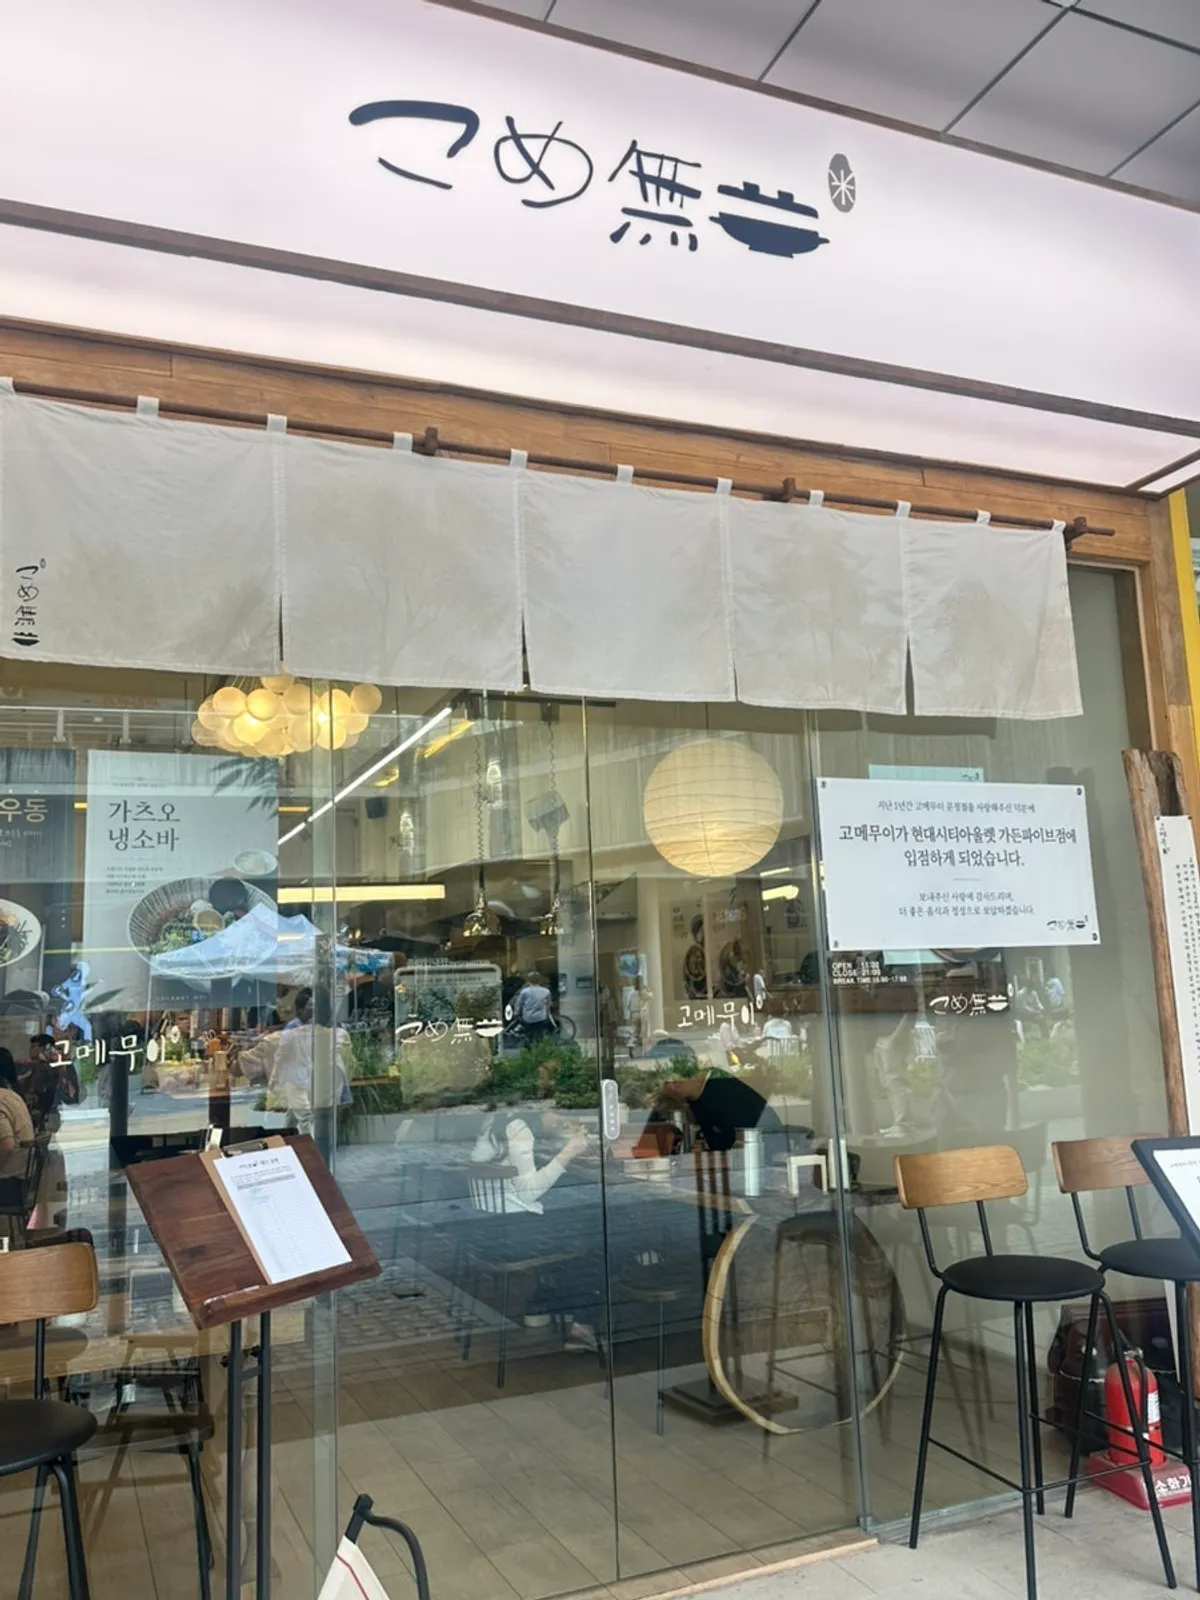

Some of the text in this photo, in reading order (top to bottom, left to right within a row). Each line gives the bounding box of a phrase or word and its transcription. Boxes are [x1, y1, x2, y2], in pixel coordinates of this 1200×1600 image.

[0, 798, 48, 823] 우동
[109, 800, 181, 823] 가츠오
[109, 827, 180, 852] 냉소바
[839, 824, 1077, 844] 고메무이가 현대시티아울렛 가든파이브점에
[904, 849, 1025, 867] 입점하게 되었습니다.
[832, 962, 853, 970] OPEN
[677, 1002, 755, 1029] 고메무이
[49, 1035, 166, 1072] 고메무이
[1155, 1474, 1192, 1492] 소화기
